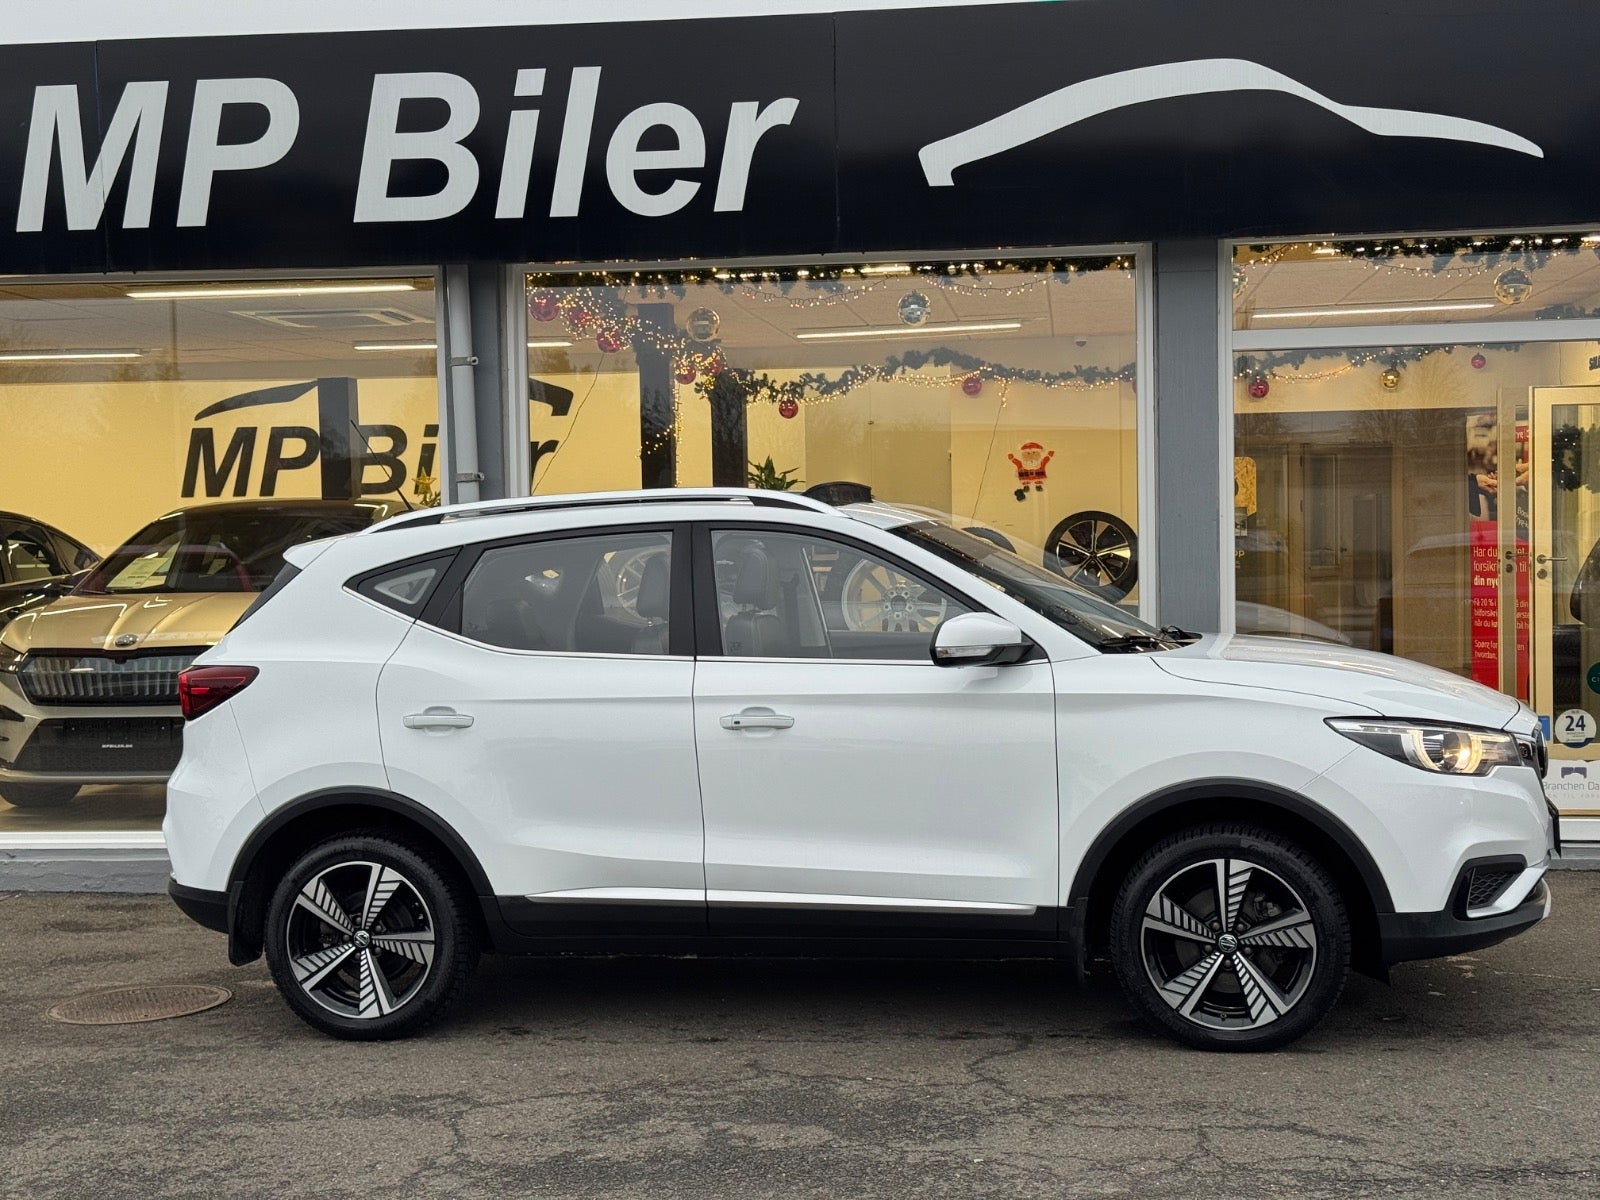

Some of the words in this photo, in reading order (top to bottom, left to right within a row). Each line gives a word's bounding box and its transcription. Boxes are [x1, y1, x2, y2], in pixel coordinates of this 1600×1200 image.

[15, 77, 300, 233] MP
[353, 66, 800, 224] Biler
[180, 425, 322, 498] MP
[1473, 546, 1486, 558] Har
[1565, 715, 1586, 732] 24
[1543, 781, 1585, 791] Branchen
